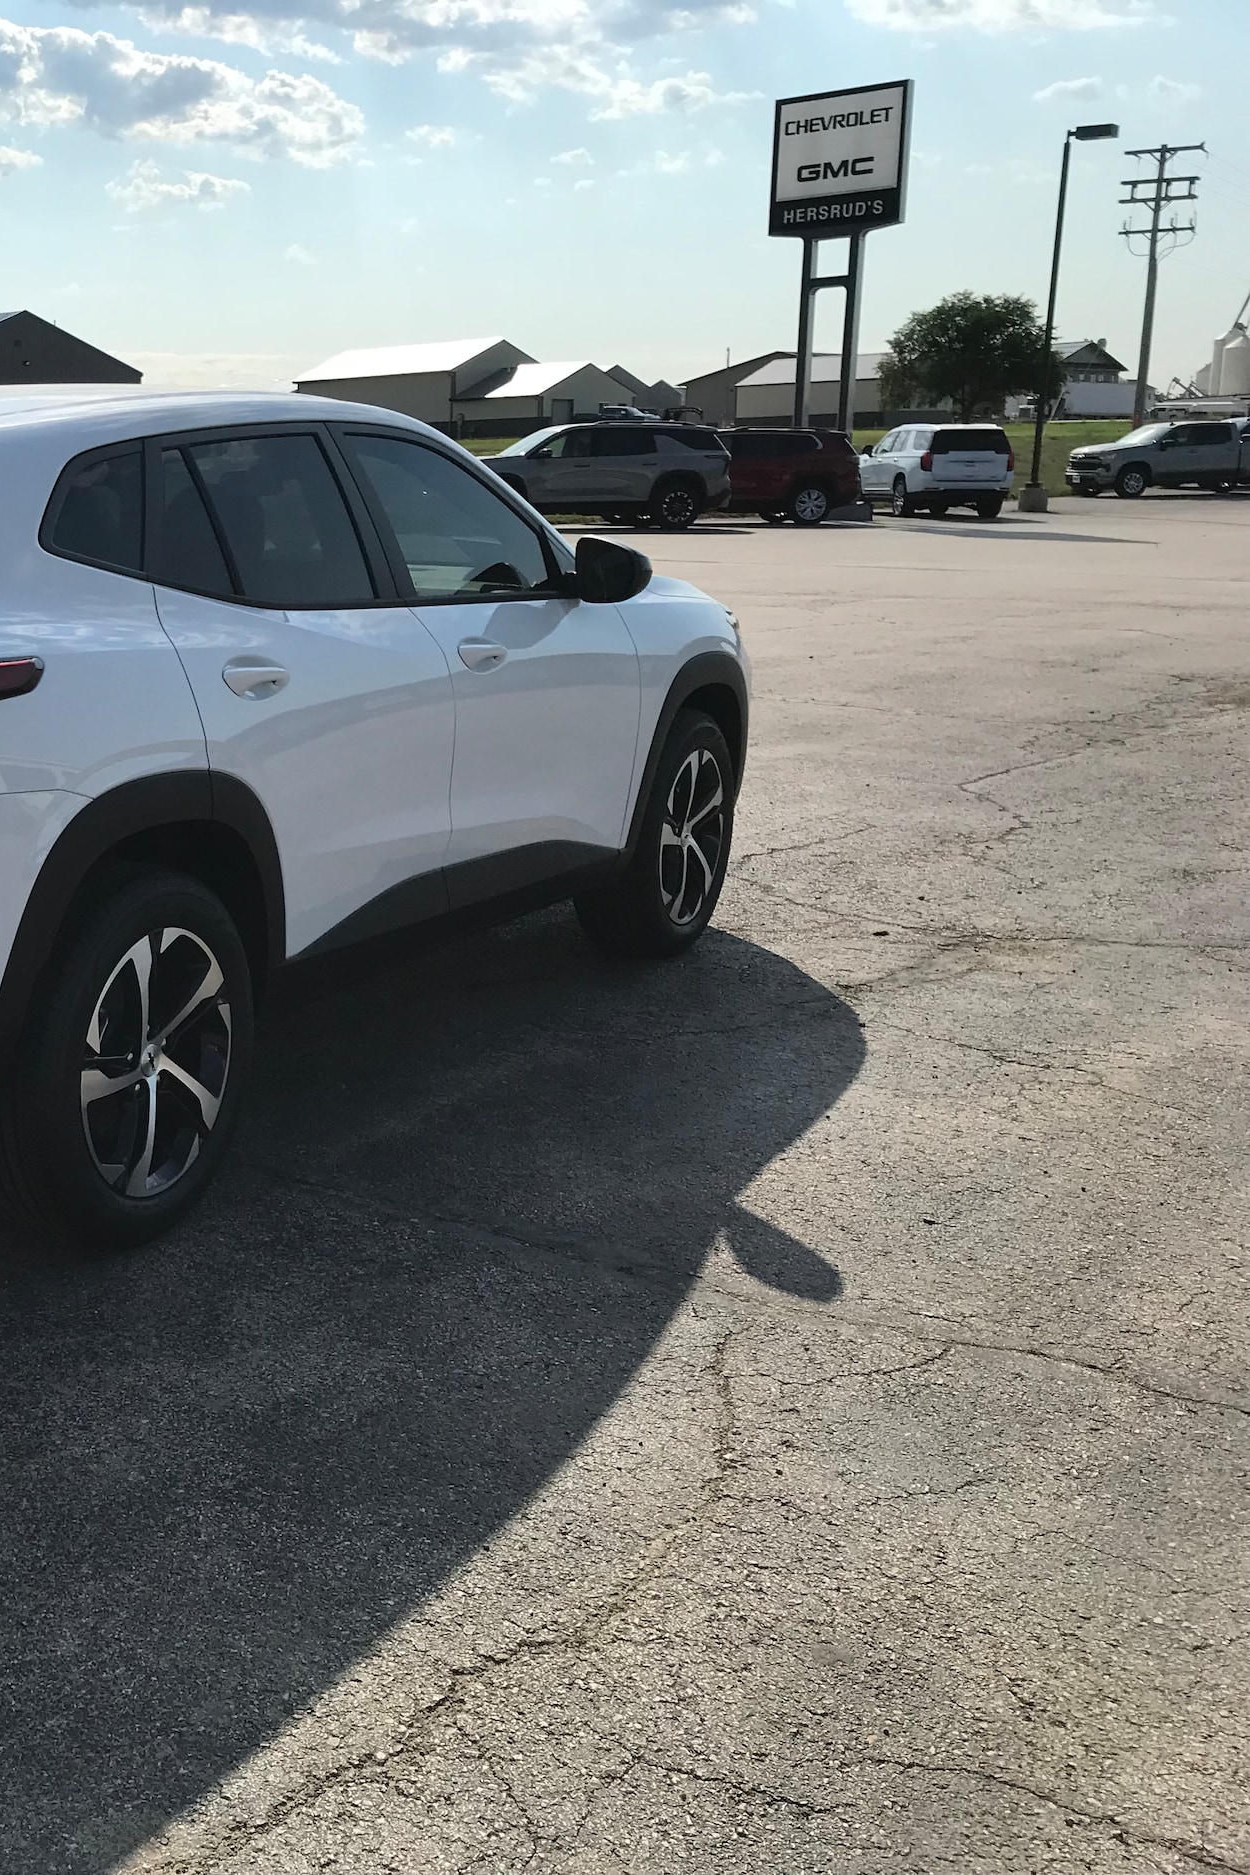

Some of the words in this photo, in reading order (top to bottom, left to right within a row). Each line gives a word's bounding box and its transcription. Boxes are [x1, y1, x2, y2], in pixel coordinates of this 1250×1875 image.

[785, 107, 894, 136] CHEVROLET
[797, 156, 874, 182] GMC
[783, 200, 884, 224] HERSRUD'S
